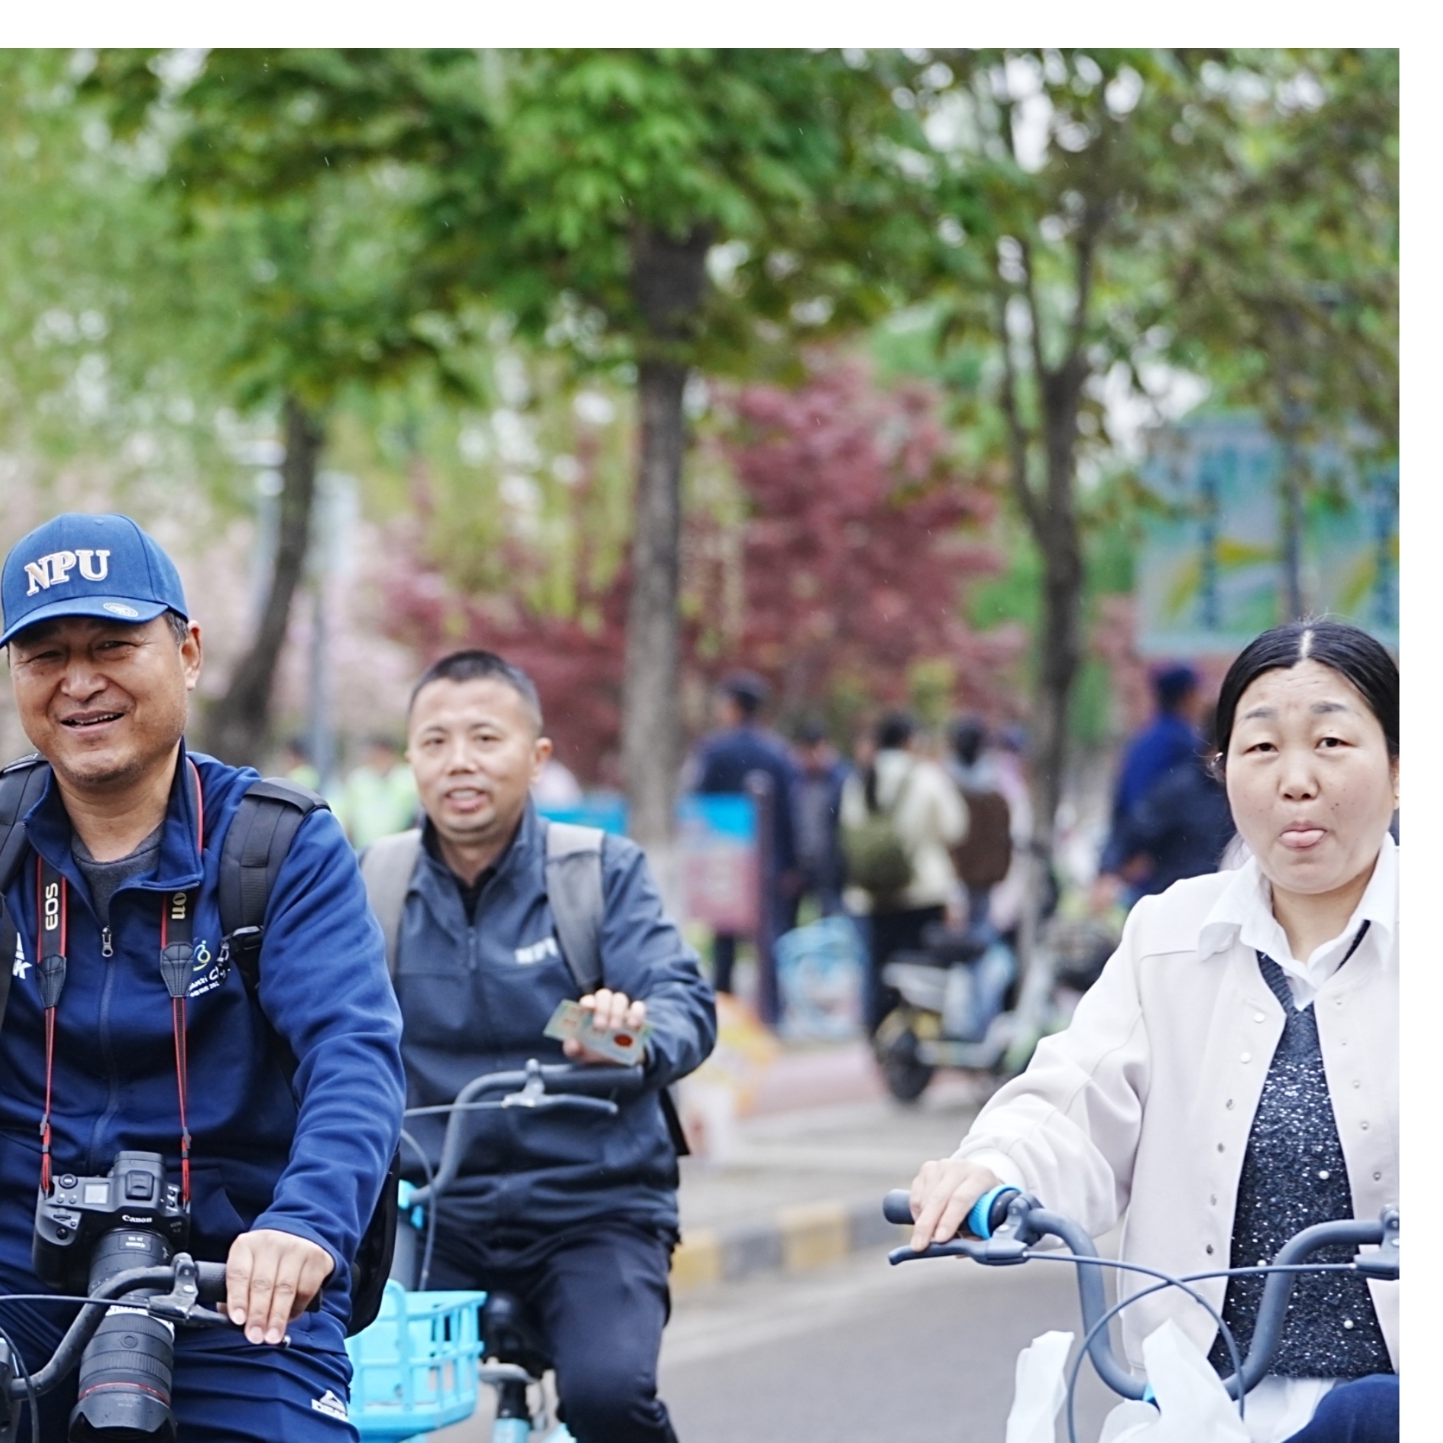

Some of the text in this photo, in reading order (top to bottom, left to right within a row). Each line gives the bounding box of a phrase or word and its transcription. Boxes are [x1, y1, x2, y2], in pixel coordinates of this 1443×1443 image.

[24, 549, 110, 596] NPU
[45, 883, 59, 931] EOS
[121, 1214, 153, 1224] Canon
